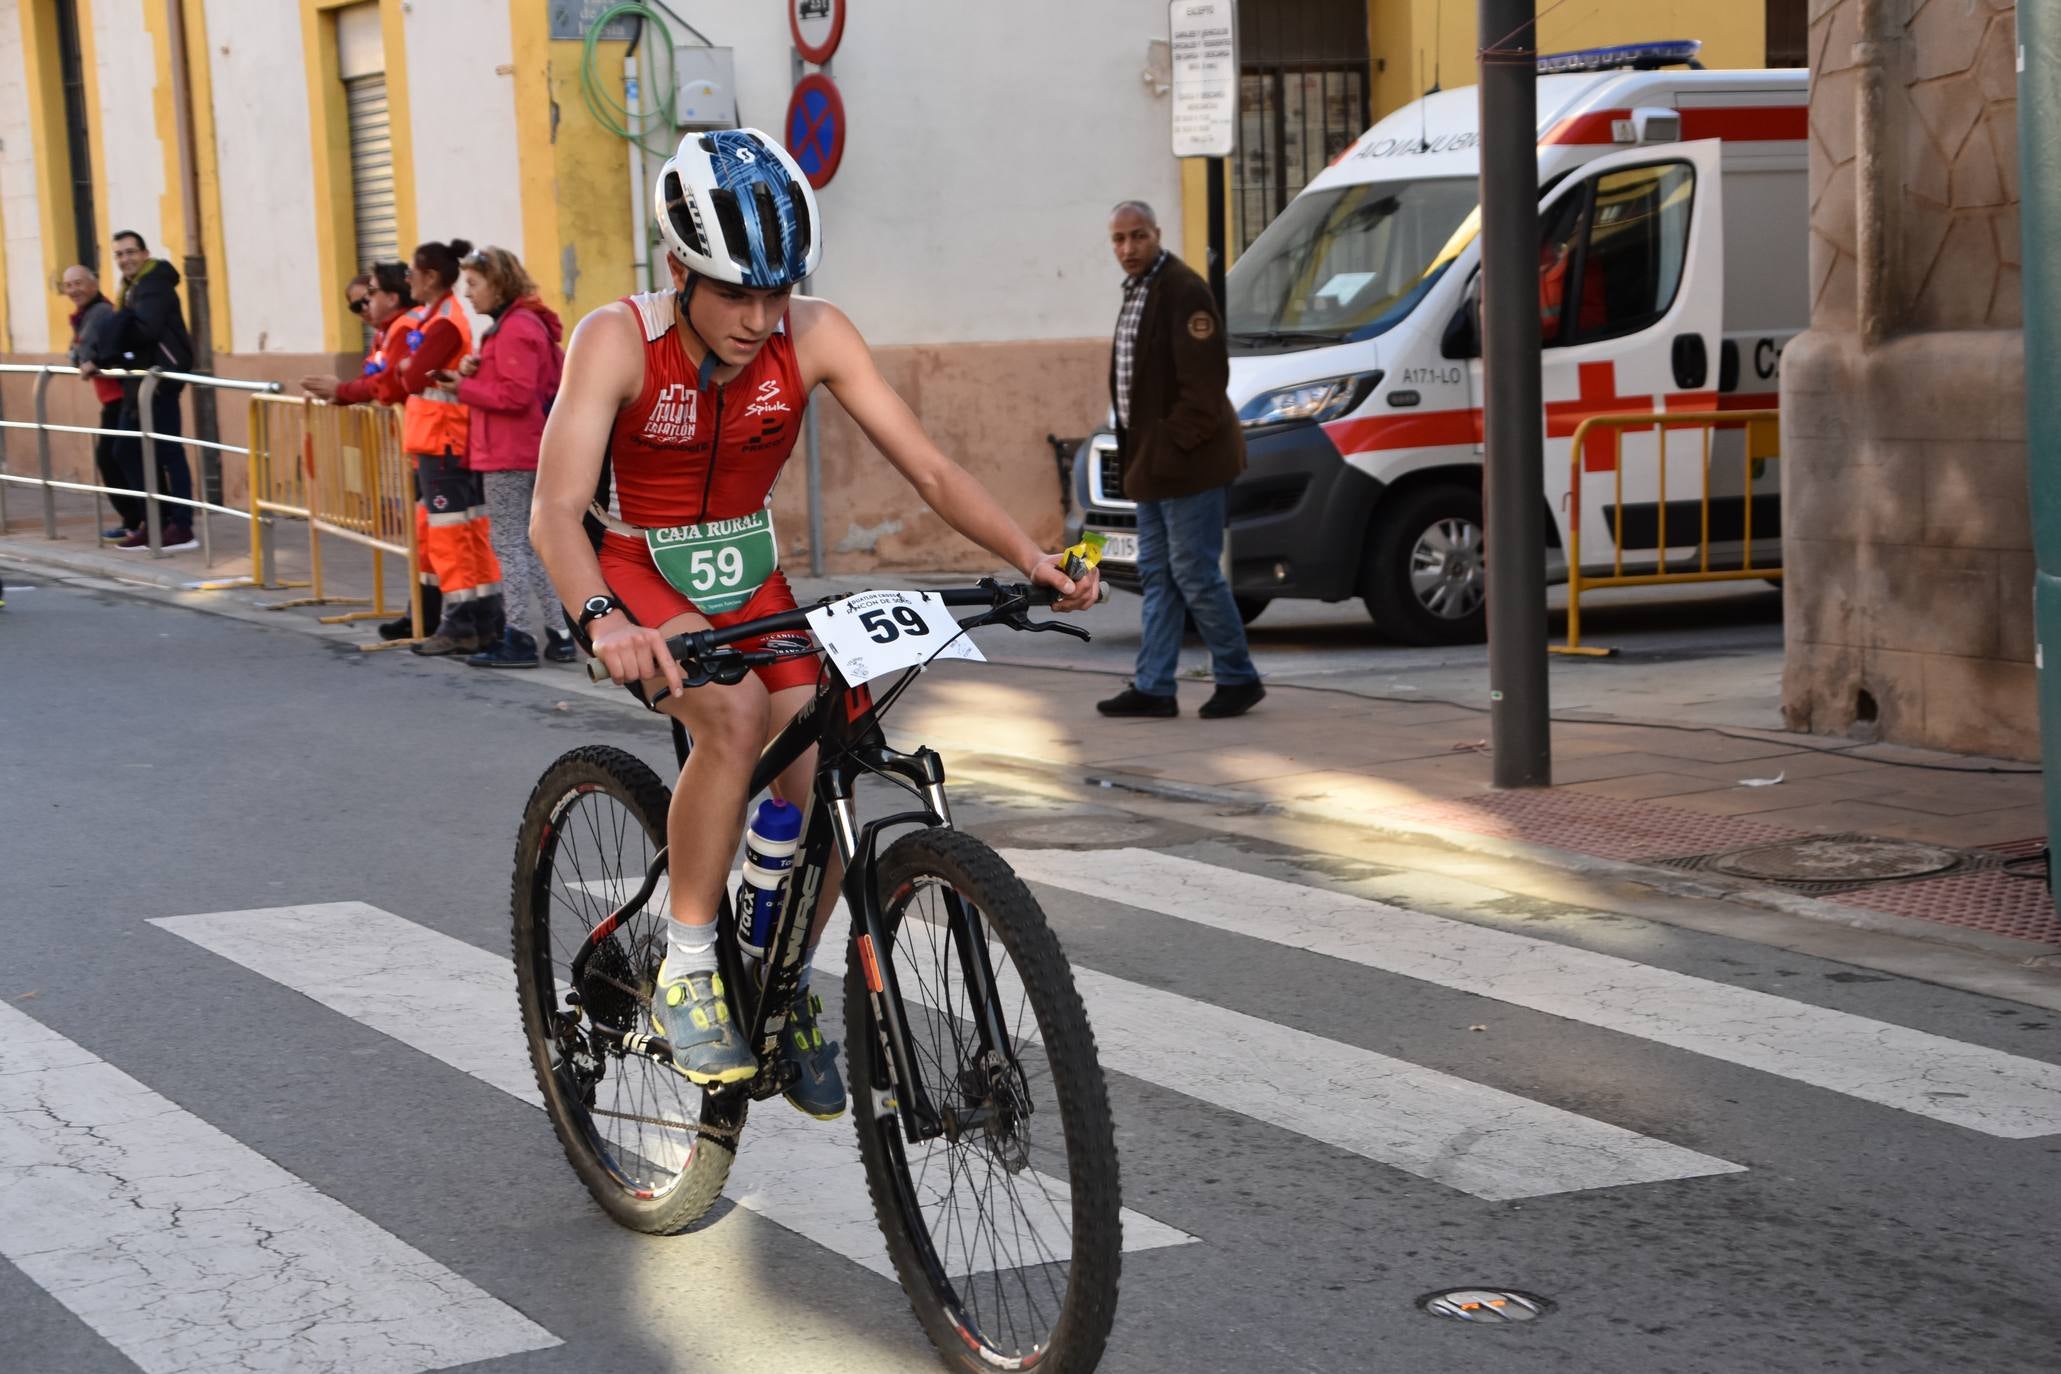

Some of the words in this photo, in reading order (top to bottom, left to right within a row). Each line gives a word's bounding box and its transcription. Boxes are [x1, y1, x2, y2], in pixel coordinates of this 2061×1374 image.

[744, 400, 791, 417] Spiuk
[656, 524, 703, 543] CAJA
[706, 512, 763, 537] RURAL
[690, 546, 744, 591] 59
[858, 605, 930, 644] 59
[740, 887, 755, 937] Tacx
